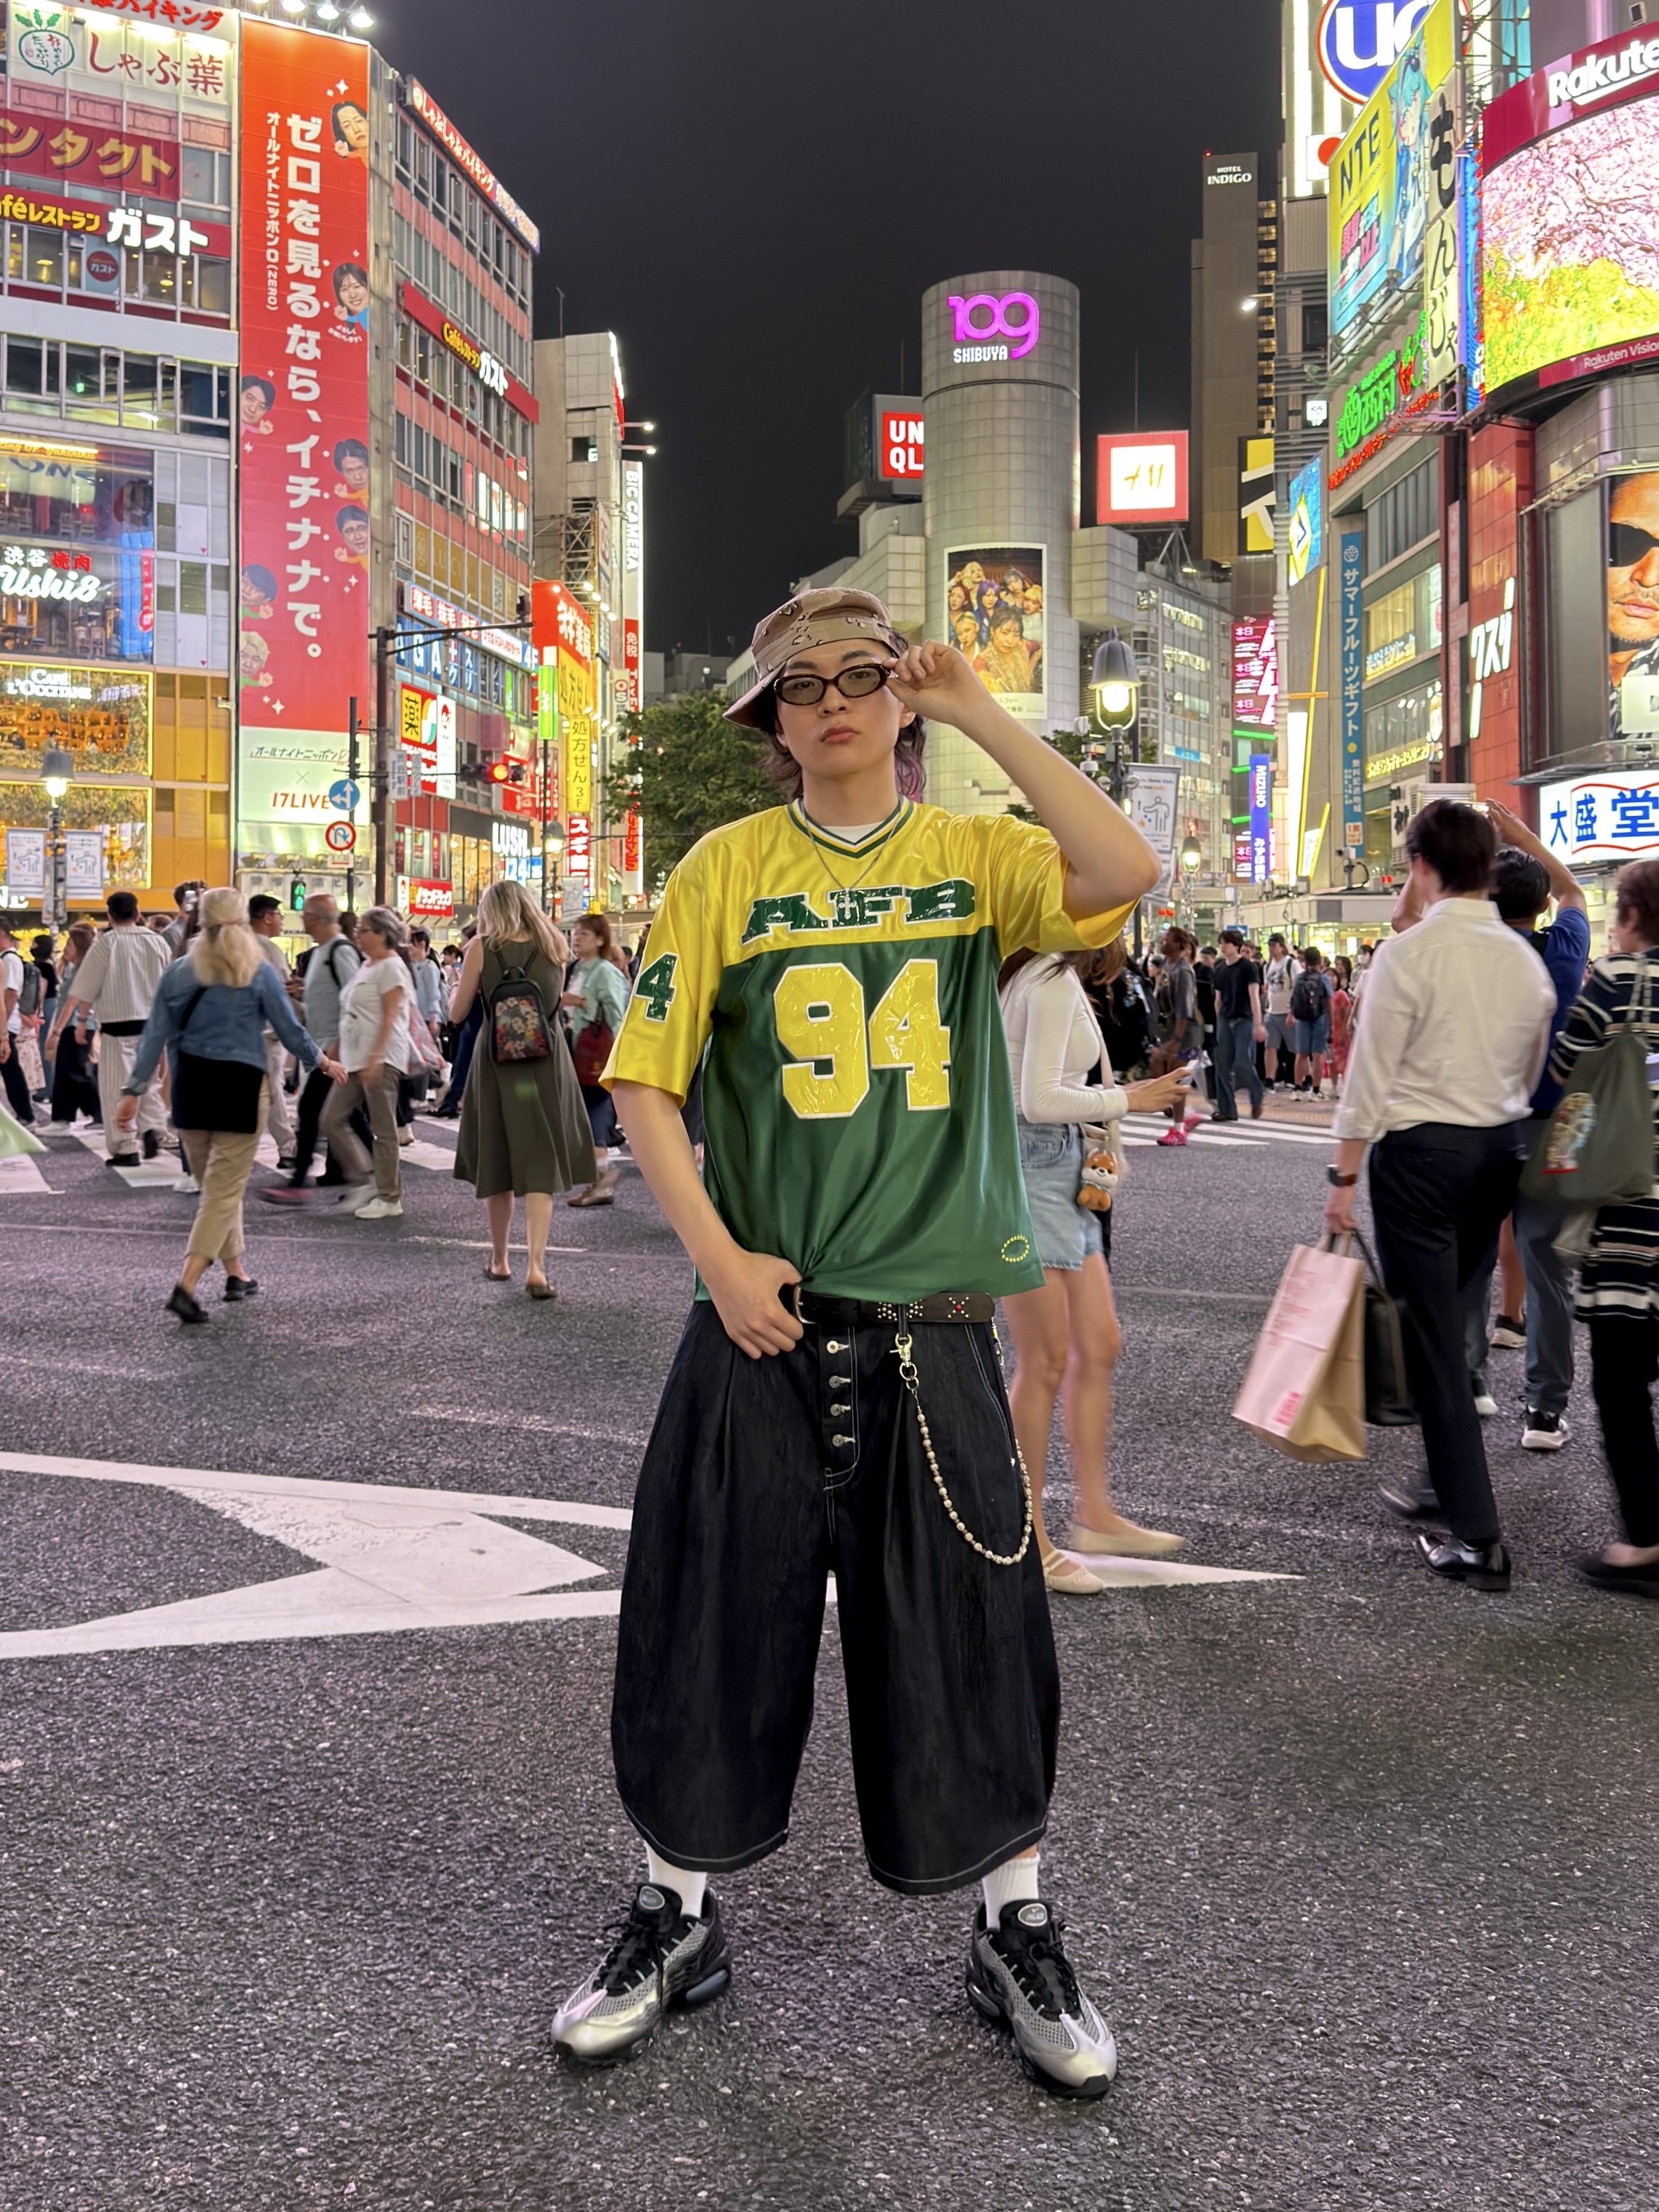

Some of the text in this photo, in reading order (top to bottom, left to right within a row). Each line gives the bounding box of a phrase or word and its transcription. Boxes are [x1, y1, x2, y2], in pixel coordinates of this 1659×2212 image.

[90, 33, 223, 95] しゃぶ葉
[1207, 172, 1252, 185] INDIGO
[1341, 108, 1381, 208] NTE
[107, 209, 209, 256] ガスト
[948, 292, 1040, 360] 109
[480, 351, 508, 396] ガスト
[953, 345, 1008, 363] SHIBUYA
[1584, 349, 1628, 368] Rakuten
[625, 470, 640, 571] BIC CAMERA
[0, 565, 101, 603] Ushi8
[524, 646, 539, 670] 4F
[1343, 569, 1360, 737] サマーフルーツギフト
[7, 678, 92, 700] L'OCCITANE
[405, 696, 419, 737] 薬
[272, 792, 330, 810] 17LIVE
[1255, 764, 1267, 808] MIZUHO
[1550, 788, 1659, 849] 大盛堂
[774, 959, 950, 1119] 94
